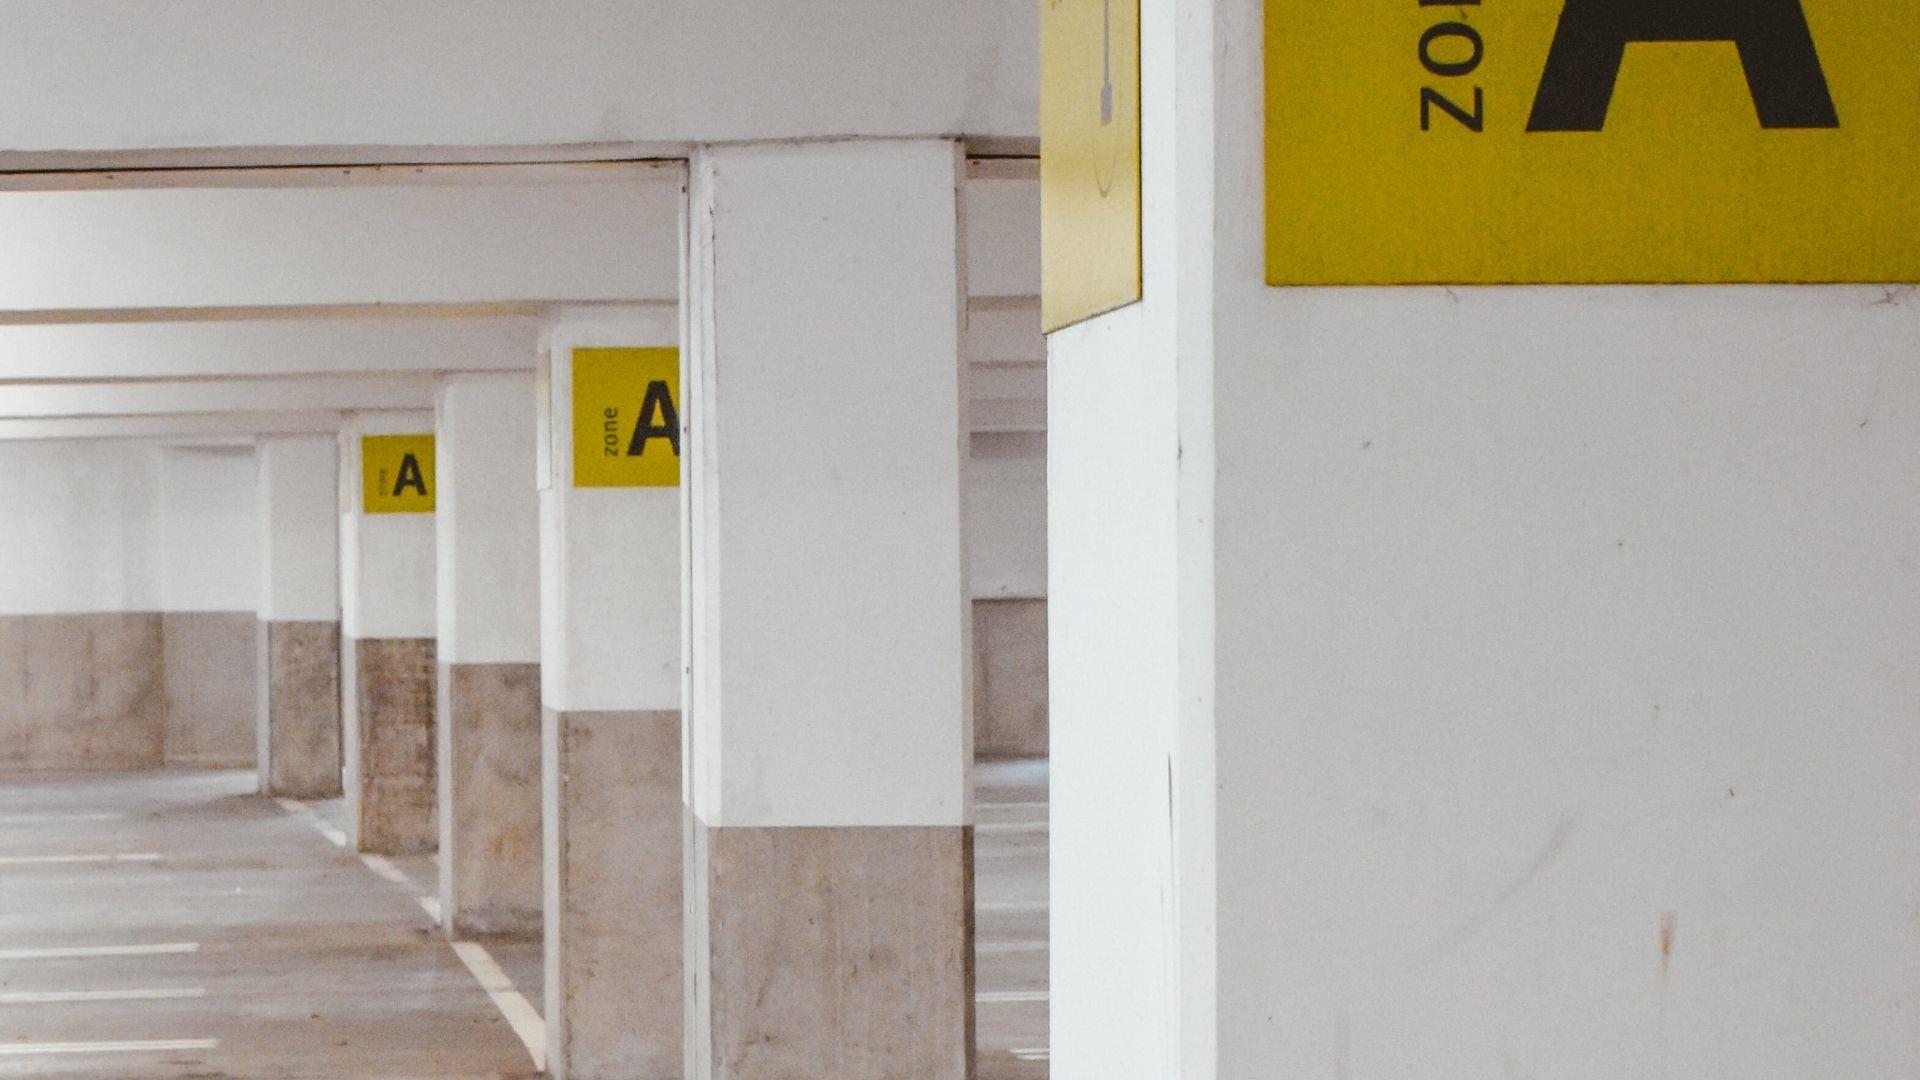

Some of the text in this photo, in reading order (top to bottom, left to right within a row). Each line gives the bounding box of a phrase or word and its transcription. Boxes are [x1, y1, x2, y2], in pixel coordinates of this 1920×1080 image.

[1418, 0, 1483, 132] zo
[604, 407, 618, 457] zone
[627, 380, 680, 456] A
[392, 453, 427, 496] A
